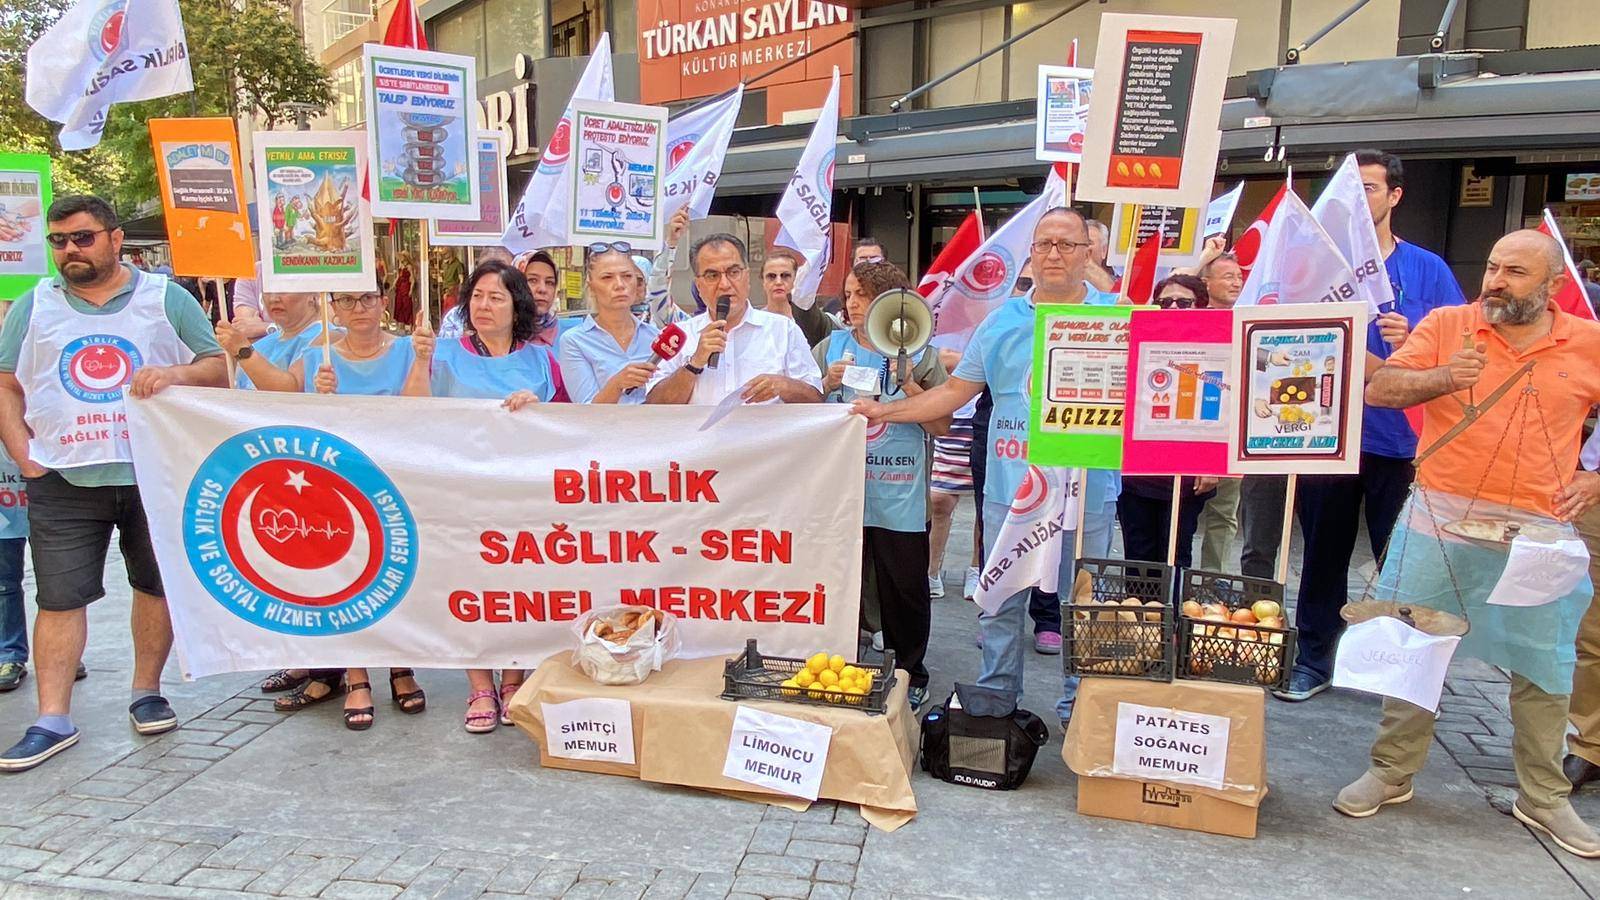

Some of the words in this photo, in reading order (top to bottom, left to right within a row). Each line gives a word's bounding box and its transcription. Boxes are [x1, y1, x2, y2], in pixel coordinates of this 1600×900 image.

[643, 12, 737, 59] TÜRKAN
[743, 0, 848, 41] SAYLAN
[682, 53, 737, 76] KÜLTÜR
[742, 37, 811, 66] MERKEZİ
[378, 93, 408, 104] TALEP
[411, 95, 456, 110] EDİYORUZ
[297, 152, 316, 161] AMA
[516, 202, 534, 239] SEN
[76, 411, 128, 426] BİRLİK
[996, 418, 1026, 431] BİRLİK
[1045, 406, 1125, 429] AÇIZZZ
[60, 429, 110, 446] SAĞLIK
[242, 434, 342, 467] BİRLİK
[894, 455, 915, 467] SEN
[553, 460, 720, 504] BİRLİK
[194, 478, 224, 536] SAĞLIK
[372, 489, 409, 565] SENDİKASI
[197, 540, 221, 563] VE
[479, 522, 661, 565] SAĞLIK
[700, 529, 794, 564] SEN
[208, 563, 257, 613] SOSYAL
[328, 568, 405, 630] ÇALIŞANLARI
[264, 602, 323, 628] HİZMET
[620, 583, 827, 625] MERKEZİ
[561, 719, 617, 737] SİMİTÇİ
[1135, 713, 1211, 735] PATATES
[563, 738, 618, 754] MEMUR
[742, 734, 815, 765] LİMONCU
[1133, 735, 1208, 756] SOĞANCI
[744, 757, 803, 785] MEMUR
[1138, 756, 1200, 775] MEMUR
